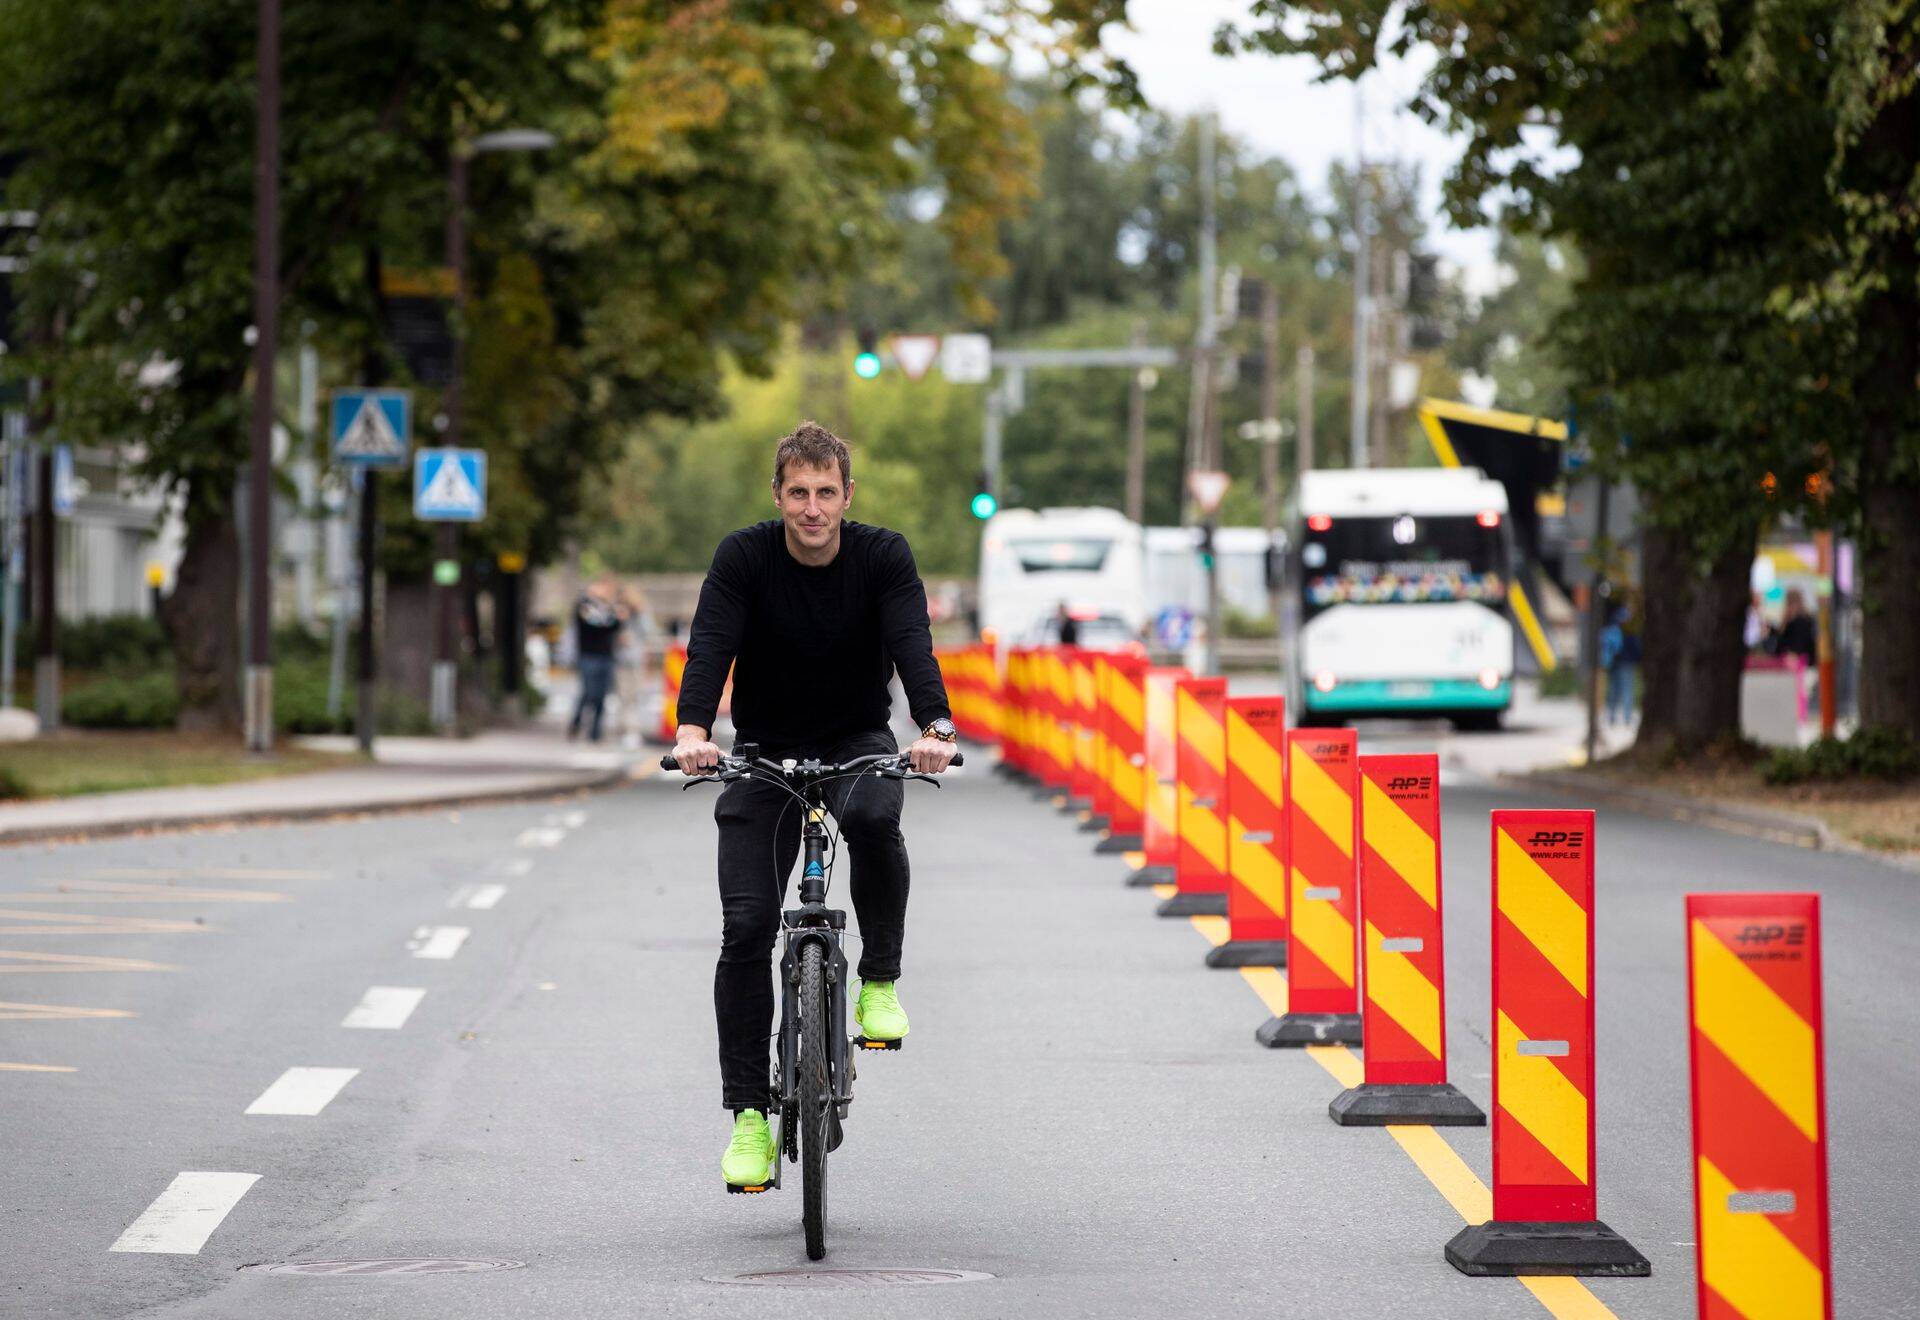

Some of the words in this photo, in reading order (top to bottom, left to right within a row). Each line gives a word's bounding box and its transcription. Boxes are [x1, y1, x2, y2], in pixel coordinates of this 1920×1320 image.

[1387, 777, 1432, 790] RPE
[1528, 832, 1584, 847] RPE
[1735, 924, 1806, 945] RPE
